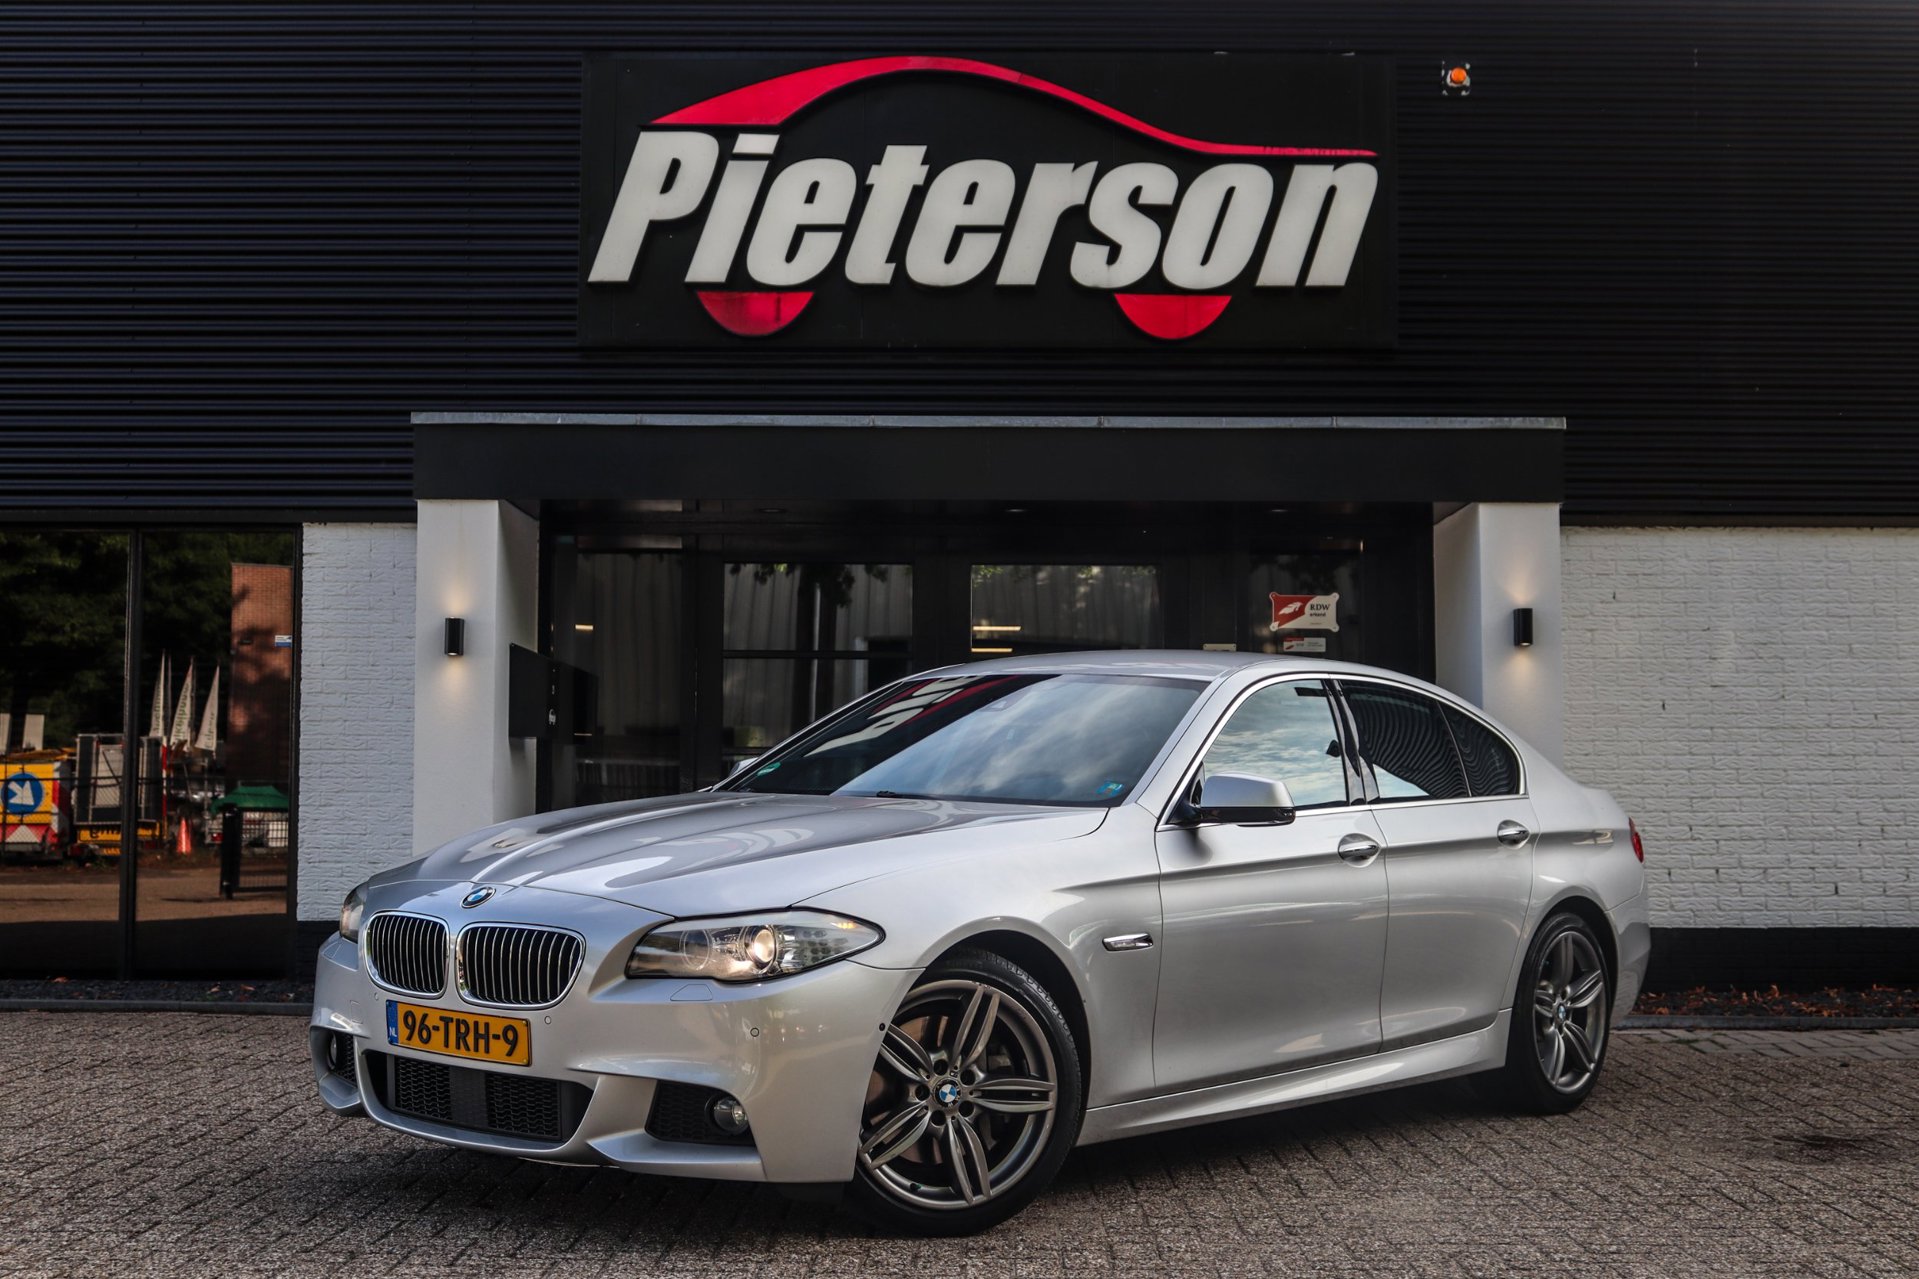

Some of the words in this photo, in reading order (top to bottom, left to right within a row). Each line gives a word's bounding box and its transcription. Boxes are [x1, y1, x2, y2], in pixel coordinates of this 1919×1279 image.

[587, 131, 1379, 289] Pieterson
[1310, 603, 1331, 611] RDW
[403, 1010, 519, 1057] 96-TRH-9
